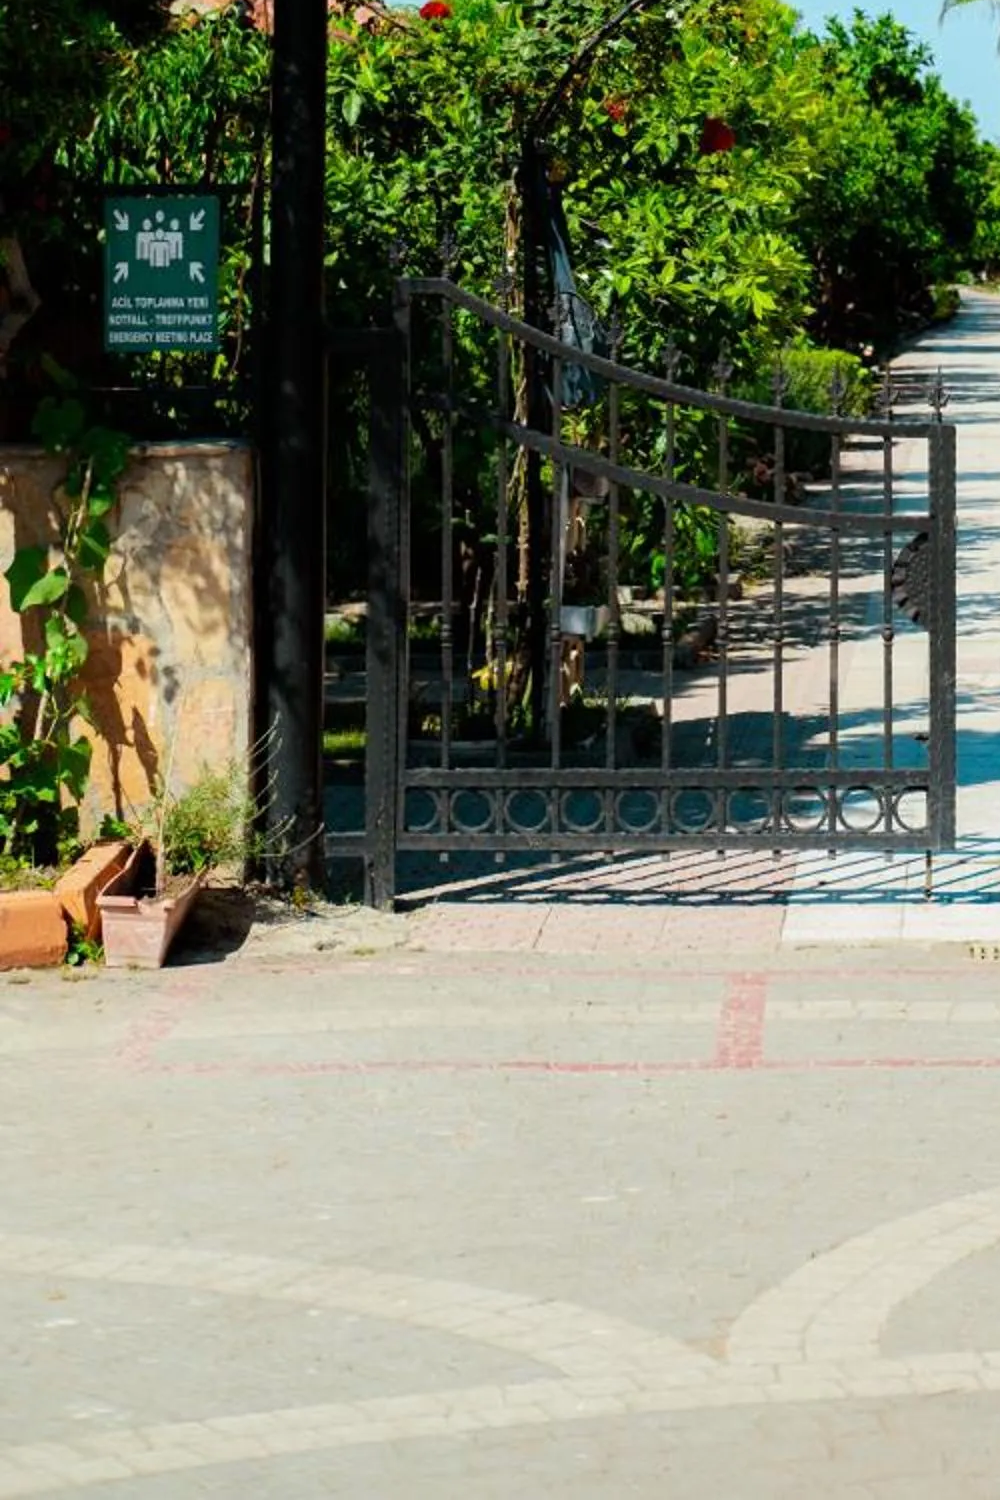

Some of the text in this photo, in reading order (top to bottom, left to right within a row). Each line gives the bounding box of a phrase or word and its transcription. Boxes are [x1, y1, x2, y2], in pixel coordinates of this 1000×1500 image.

[109, 331, 213, 343] EMERGENCY MEETING PLACE
